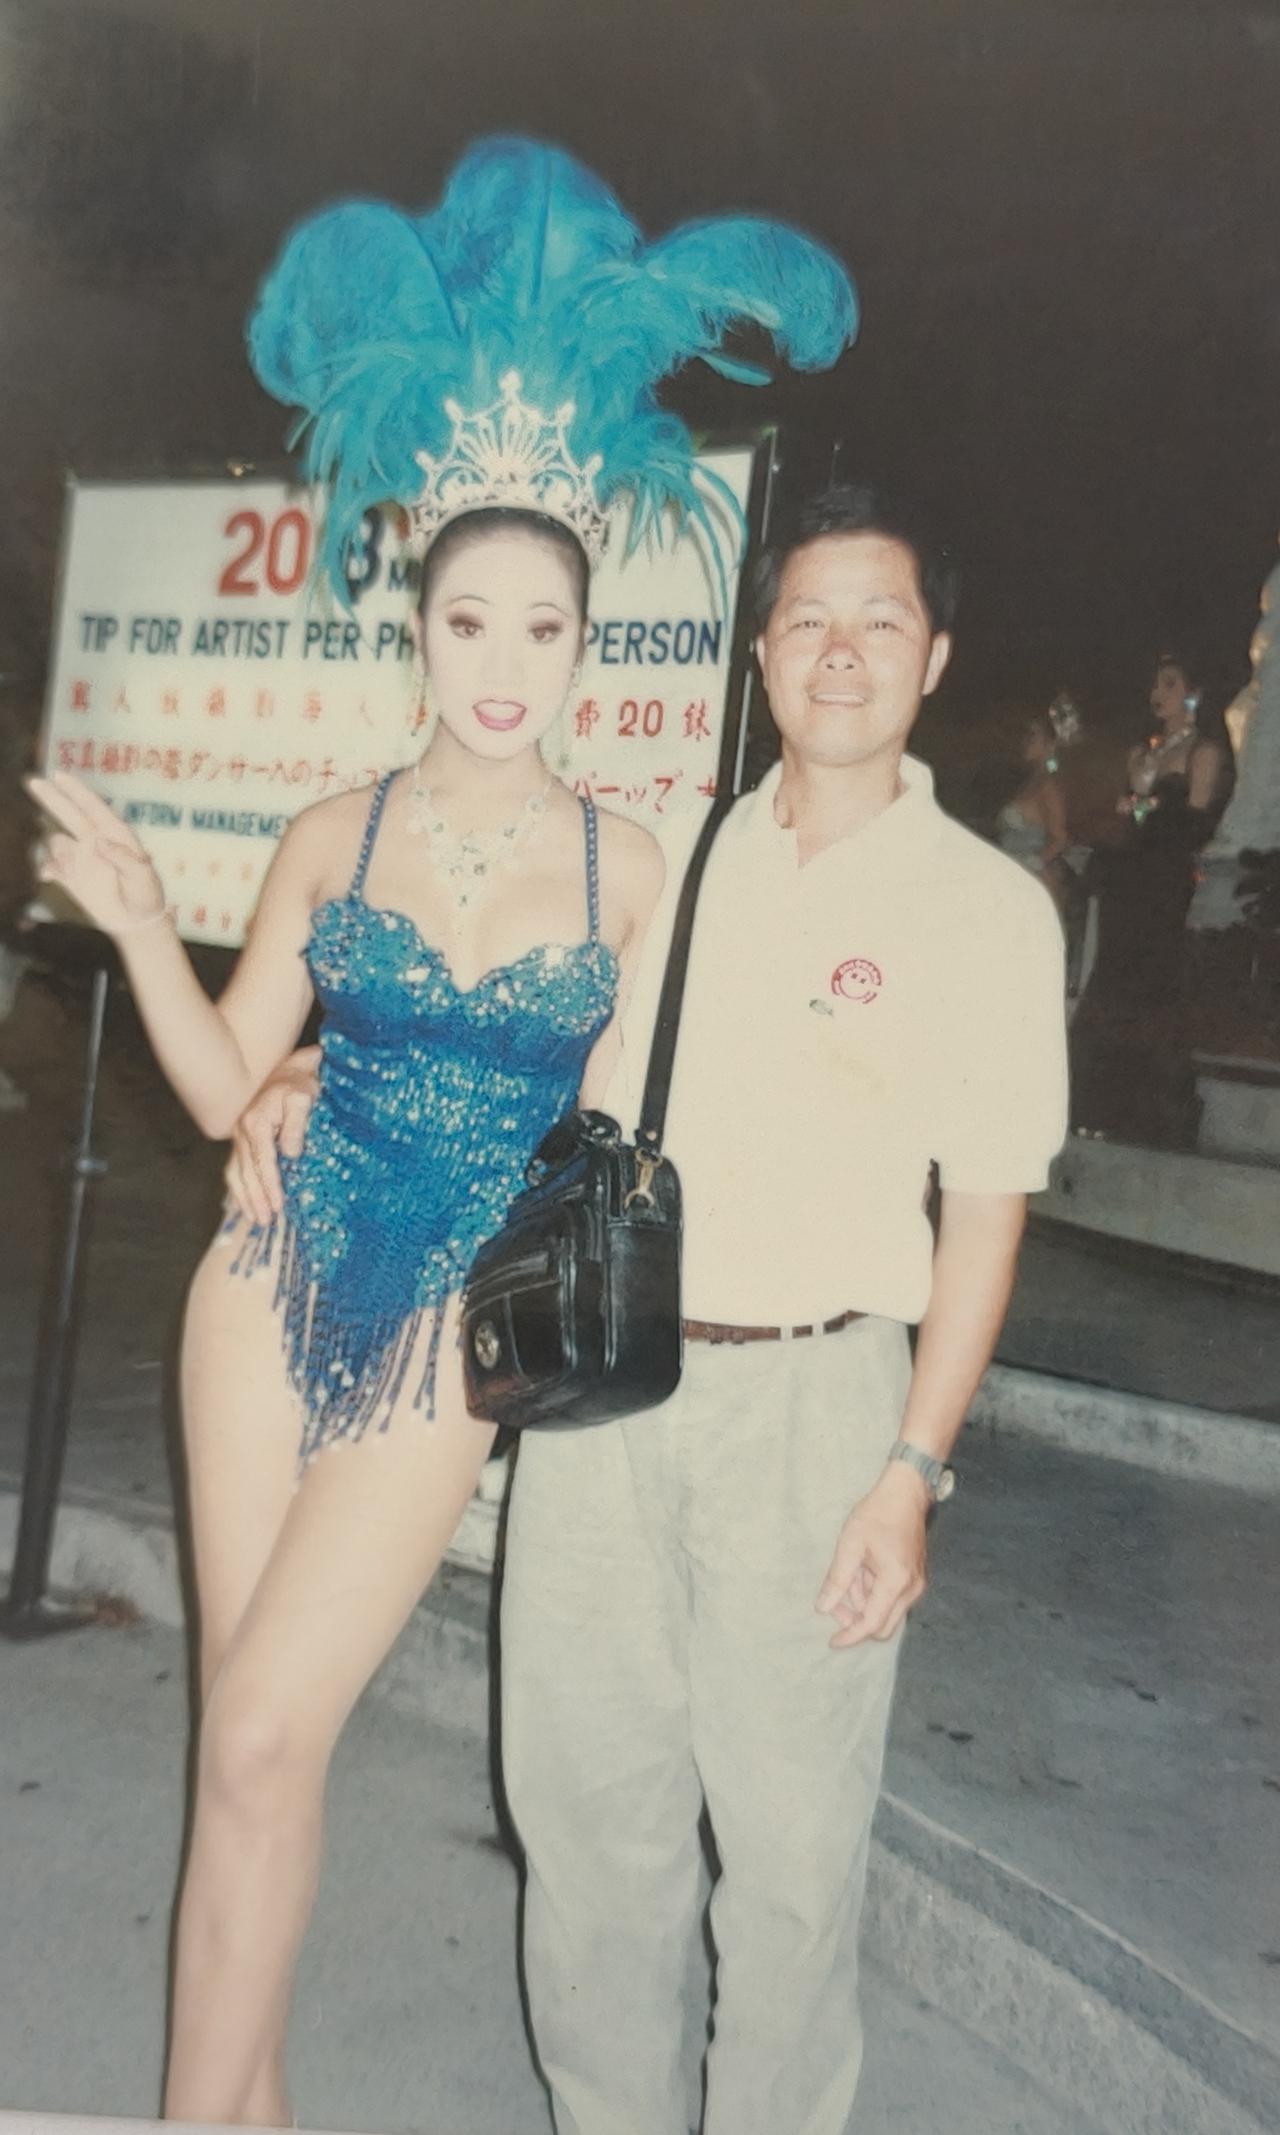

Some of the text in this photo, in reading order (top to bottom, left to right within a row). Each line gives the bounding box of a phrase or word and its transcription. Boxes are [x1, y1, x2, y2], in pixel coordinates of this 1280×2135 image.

[217, 508, 310, 597] 20
[81, 616, 119, 652] TIP
[128, 617, 182, 655] FOR
[192, 620, 290, 659] ARTIST
[303, 621, 361, 661] PER
[618, 699, 664, 738] 20
